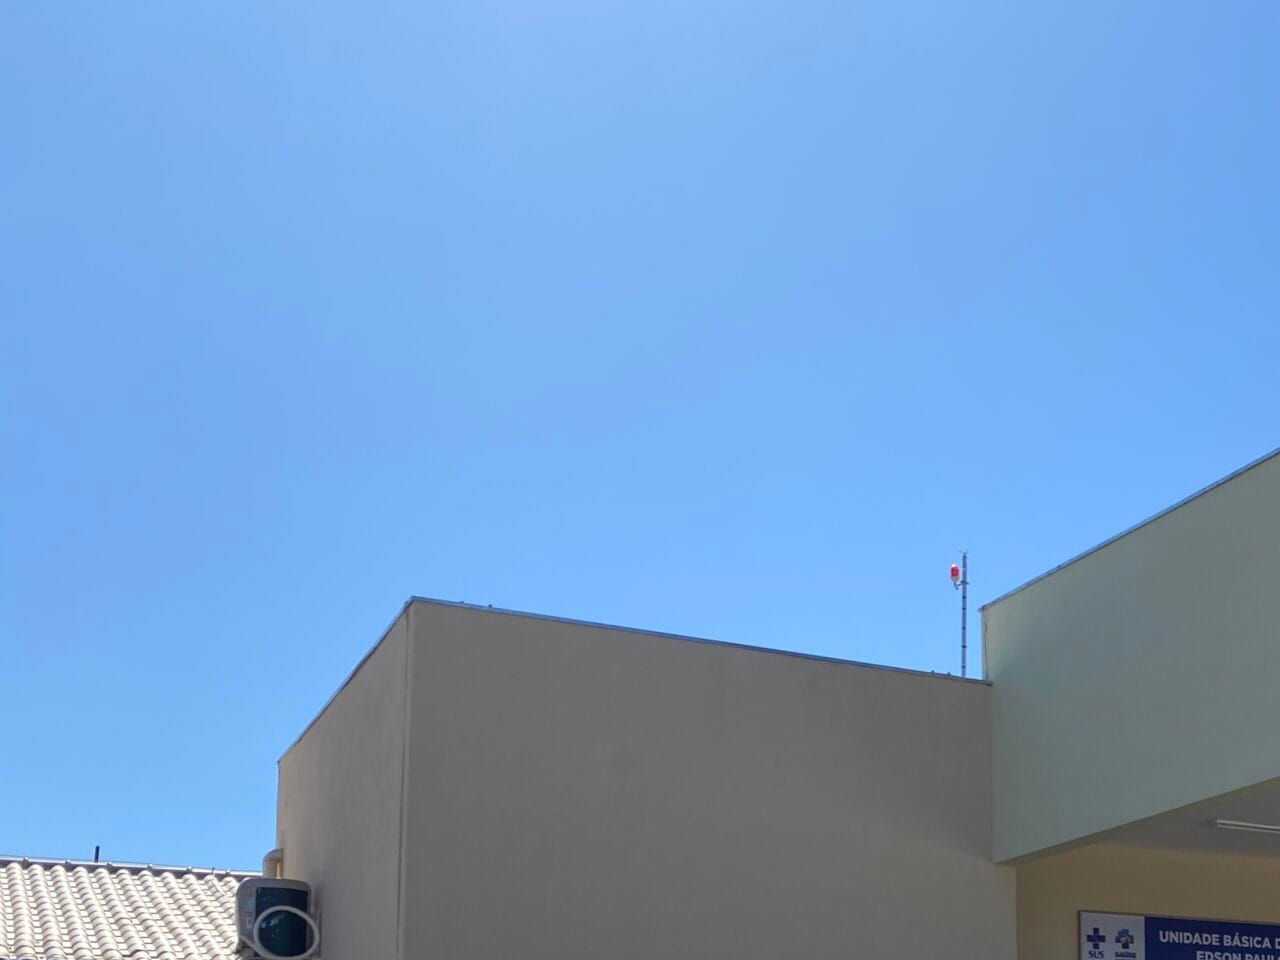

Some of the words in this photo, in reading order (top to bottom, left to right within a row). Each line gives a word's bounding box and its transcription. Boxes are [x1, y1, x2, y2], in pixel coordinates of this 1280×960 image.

[1159, 930, 1220, 946] UNIDADE
[1223, 932, 1272, 949] BÁSICA
[1088, 950, 1104, 959] SUS
